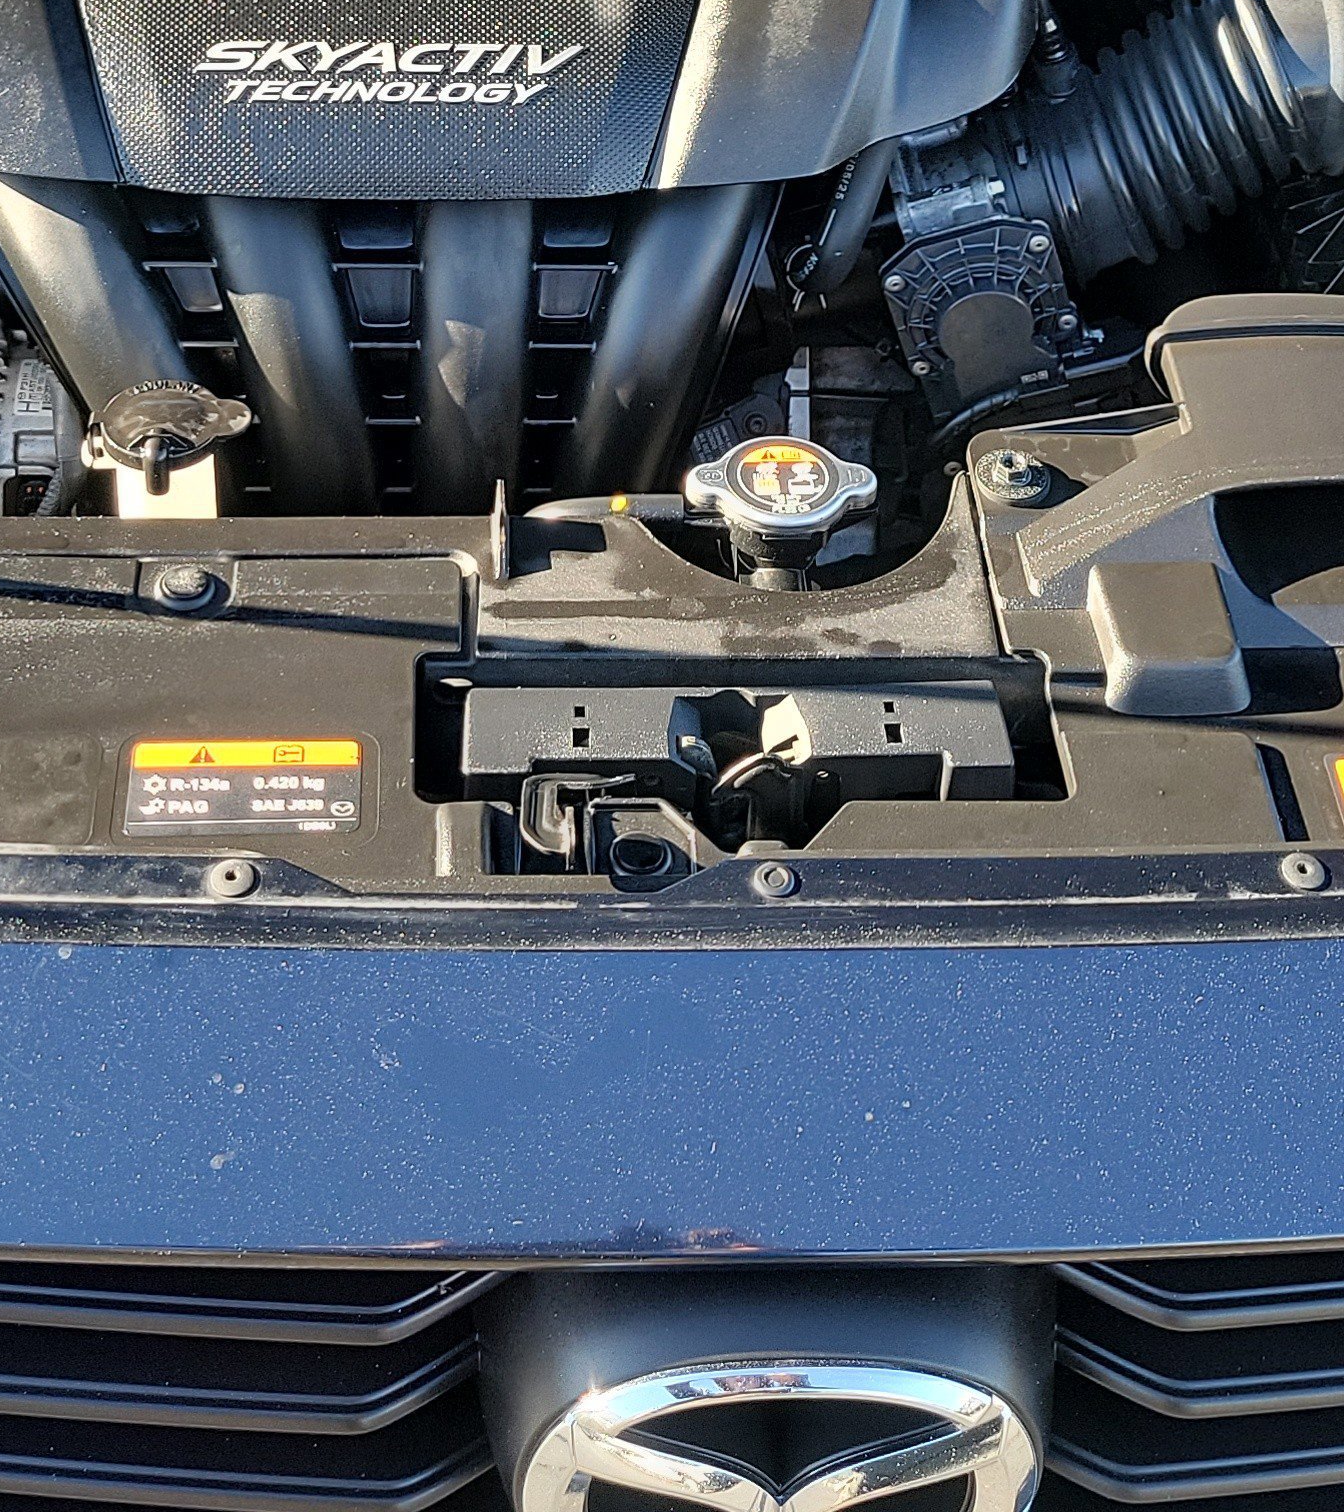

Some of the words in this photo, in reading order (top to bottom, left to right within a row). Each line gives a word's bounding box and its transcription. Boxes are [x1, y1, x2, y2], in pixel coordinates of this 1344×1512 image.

[192, 41, 584, 75] SKYACTIV
[224, 80, 548, 106] TECHNOLOGY
[170, 778, 230, 791] R-134a
[253, 776, 299, 789] 0.420
[303, 776, 325, 791] kg
[167, 800, 209, 814] PAG
[252, 799, 286, 812] SAE
